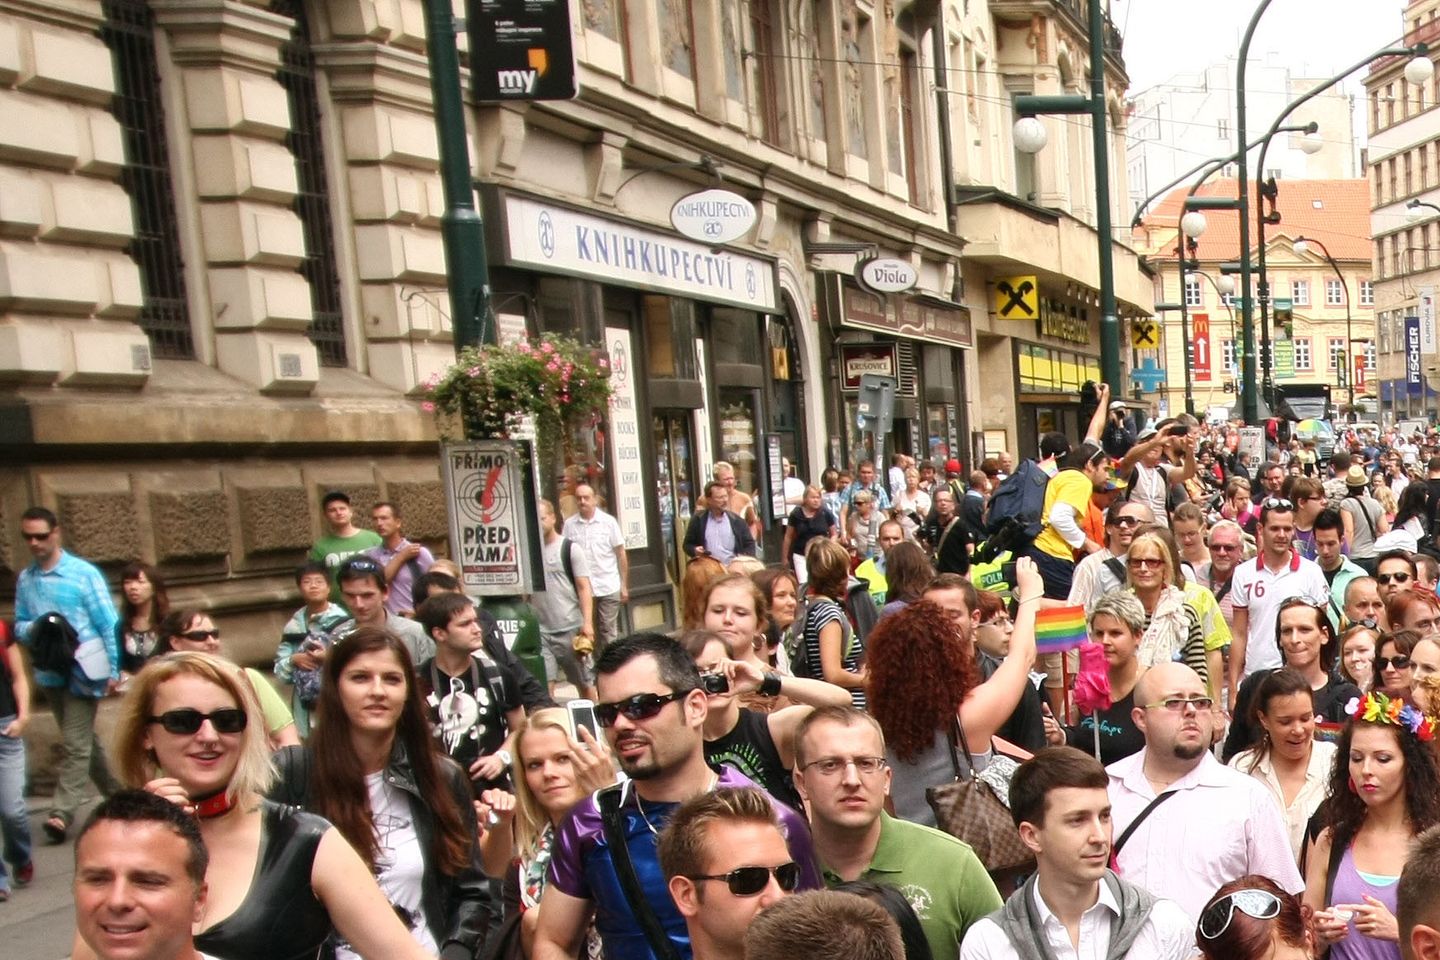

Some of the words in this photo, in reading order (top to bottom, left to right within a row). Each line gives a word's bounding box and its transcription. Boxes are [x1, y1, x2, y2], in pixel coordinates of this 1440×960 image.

[576, 224, 733, 291] KNIHKUPECTVÍ
[874, 267, 908, 284] Viola
[1408, 326, 1421, 383] FISCHER
[464, 524, 511, 545] PŘED
[1243, 580, 1266, 601] 76
